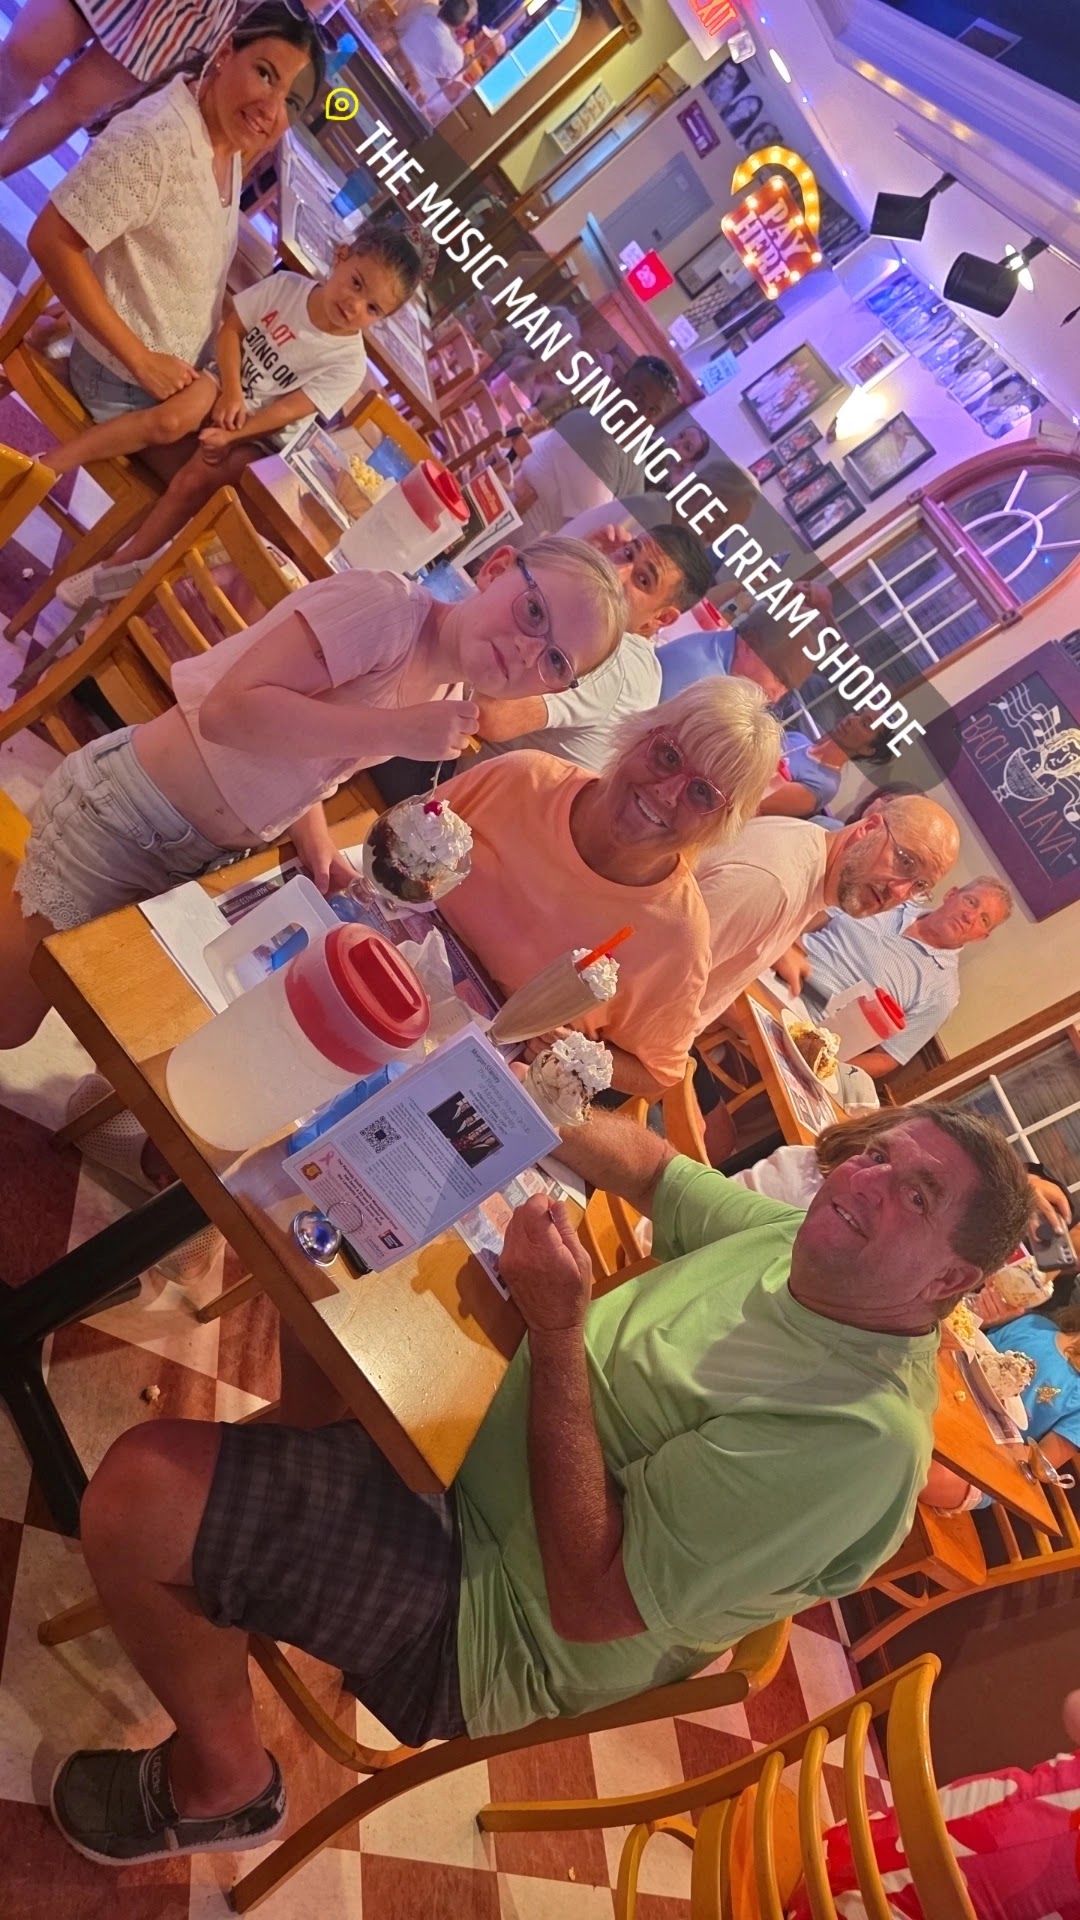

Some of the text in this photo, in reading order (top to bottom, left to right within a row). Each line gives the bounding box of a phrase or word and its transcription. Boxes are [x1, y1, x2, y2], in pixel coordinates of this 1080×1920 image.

[689, 0, 737, 36] XIT
[731, 209, 791, 290] HERE
[757, 195, 812, 261] PAY
[261, 310, 279, 328] A
[272, 363, 298, 389] ON
[960, 715, 1011, 771] BACH
[1017, 796, 1077, 866] LAVA
